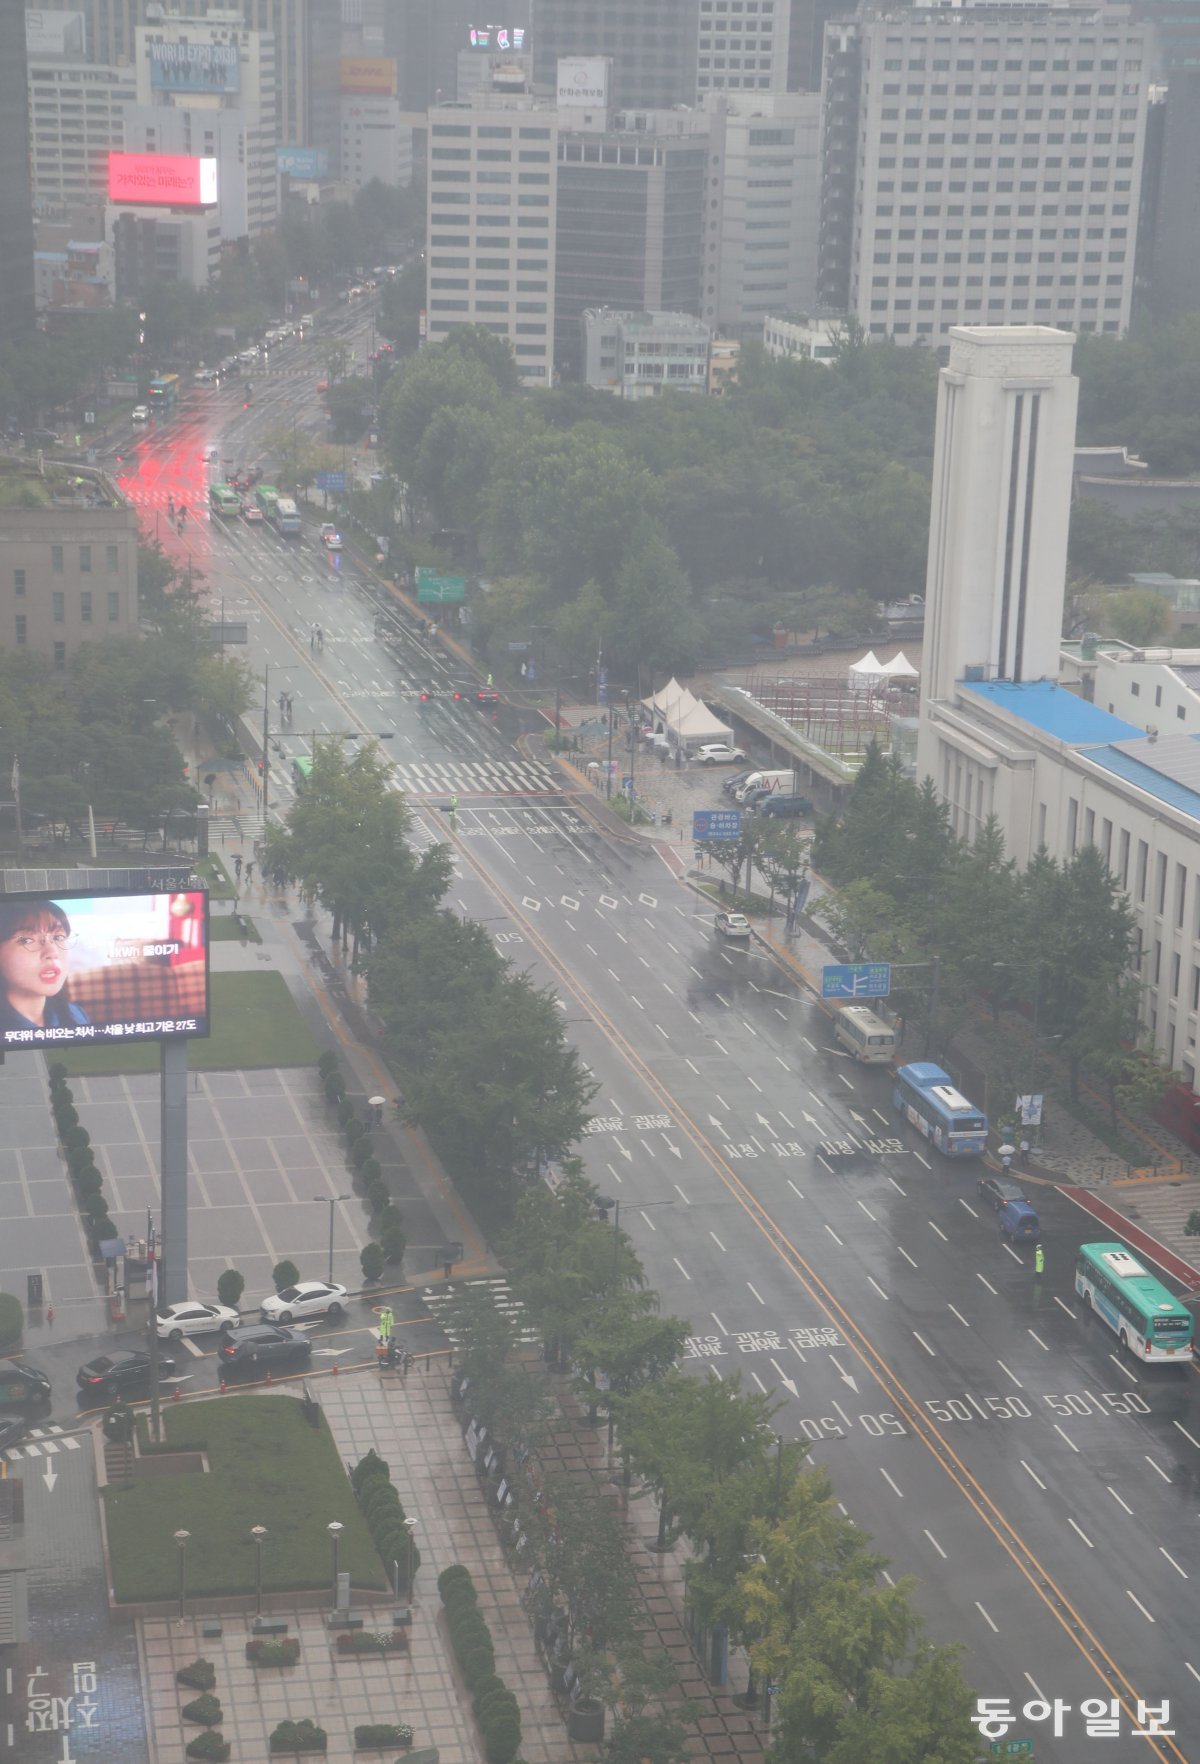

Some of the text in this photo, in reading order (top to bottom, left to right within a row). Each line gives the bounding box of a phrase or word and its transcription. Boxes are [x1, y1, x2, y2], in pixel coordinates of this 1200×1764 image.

[152, 44, 236, 64] WORLD EXPO 2030
[117, 174, 157, 187] 가치있는
[495, 932, 524, 943] 50
[143, 943, 179, 956] 줄이기
[4, 1030, 33, 1042] 무더위
[35, 1030, 44, 1040] 속
[45, 1028, 74, 1039] 비오는
[125, 1024, 135, 1035] 낮
[136, 1023, 154, 1034] 최고
[155, 1021, 175, 1033] 기온
[175, 1019, 196, 1031] 27도
[630, 1114, 677, 1130] 광화문
[723, 1143, 758, 1158] 시청
[771, 1142, 806, 1157] 시청
[820, 1140, 855, 1155] 시청
[862, 1138, 911, 1154] 서소문
[731, 1330, 788, 1353] 광화문
[788, 1327, 846, 1348] 광화문
[924, 1399, 973, 1421] 50
[984, 1396, 1032, 1418] 50
[1043, 1394, 1092, 1415] 50
[1101, 1392, 1152, 1413] 50
[800, 1417, 844, 1440] 50
[858, 1413, 907, 1436] 50
[27, 1661, 97, 1698] 입구
[25, 1695, 100, 1732] 주차장
